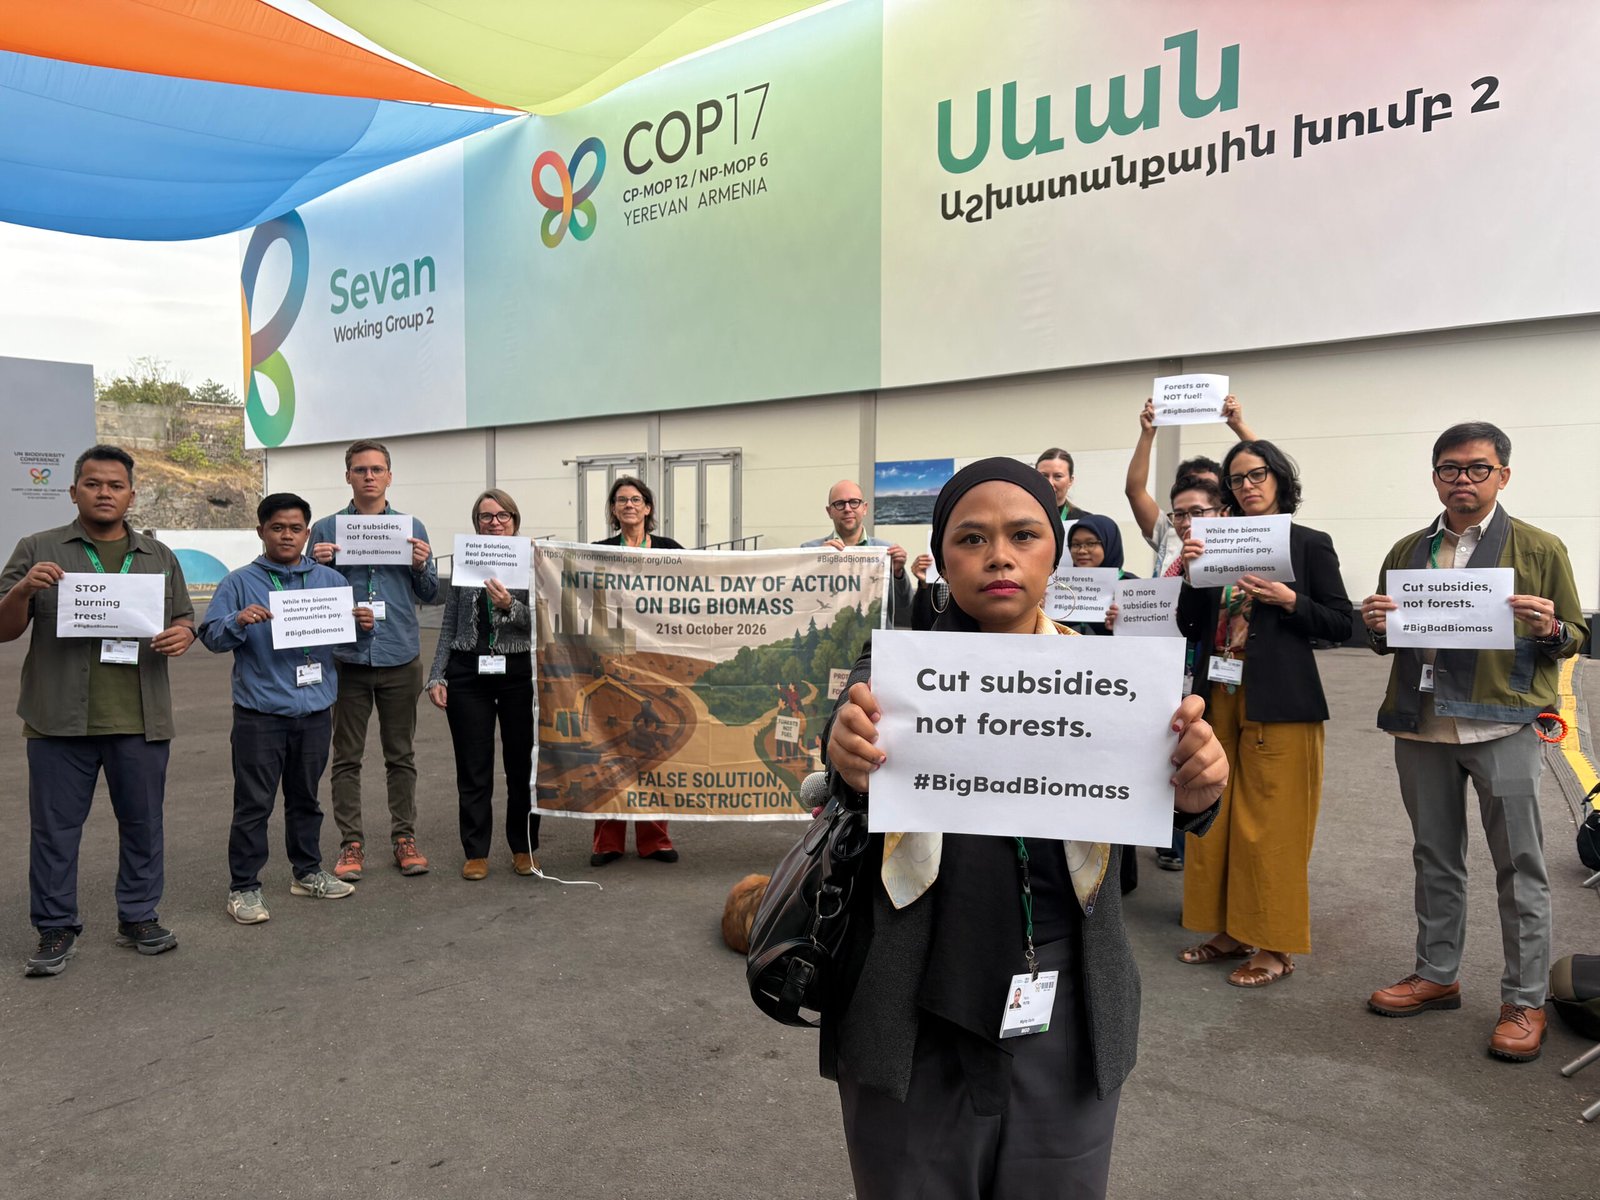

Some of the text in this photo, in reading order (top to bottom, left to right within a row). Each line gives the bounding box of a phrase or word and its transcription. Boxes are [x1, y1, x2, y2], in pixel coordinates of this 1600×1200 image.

[937, 29, 1240, 175] Սևան
[623, 82, 770, 175] COP17
[941, 75, 1500, 223] Աշխատանքային խումբ 2
[623, 178, 673, 203] CP-MOP
[675, 174, 688, 190] 12
[699, 156, 756, 183] NP-MOP
[759, 152, 769, 167] 6
[624, 177, 768, 226] YEREVAN ARMENIA
[330, 255, 436, 315] Sevan
[333, 306, 434, 343] Working Group 2
[1162, 407, 1217, 415] #BigBadBiomass
[362, 523, 402, 532] subsidies,
[362, 533, 391, 541] forests.
[1236, 536, 1261, 544] profits,
[483, 543, 512, 551] Solution,
[1204, 546, 1274, 555] communities pay.
[464, 559, 518, 567] #BigBadBiomass
[817, 554, 880, 564] #BigBadBiomass
[1203, 565, 1276, 574] #BigBadBiomass
[561, 570, 861, 592] INTERNATIONAL DAY OF ACTION
[75, 584, 106, 592] STOP
[1402, 582, 1492, 593] Cut subsidies,
[75, 598, 120, 608] burning
[635, 596, 794, 615] ON BIG BIOMASS
[1122, 601, 1158, 610] subsidies
[1403, 599, 1475, 608] not forests.
[74, 612, 106, 620] trees!
[283, 614, 327, 622] communities
[1123, 613, 1169, 623] destruction!
[285, 627, 344, 637] #BigBadBiomass
[656, 623, 766, 635] 21st October 2026
[1402, 624, 1493, 633] #BigBadBiomass
[916, 668, 1137, 702] Cut subsidies,
[916, 712, 1092, 738] not forests.
[637, 771, 783, 790] FALSE SOLUTION,
[913, 773, 1130, 800] #BigBadBiomass
[626, 792, 792, 809] REAL DESTRUCTION
